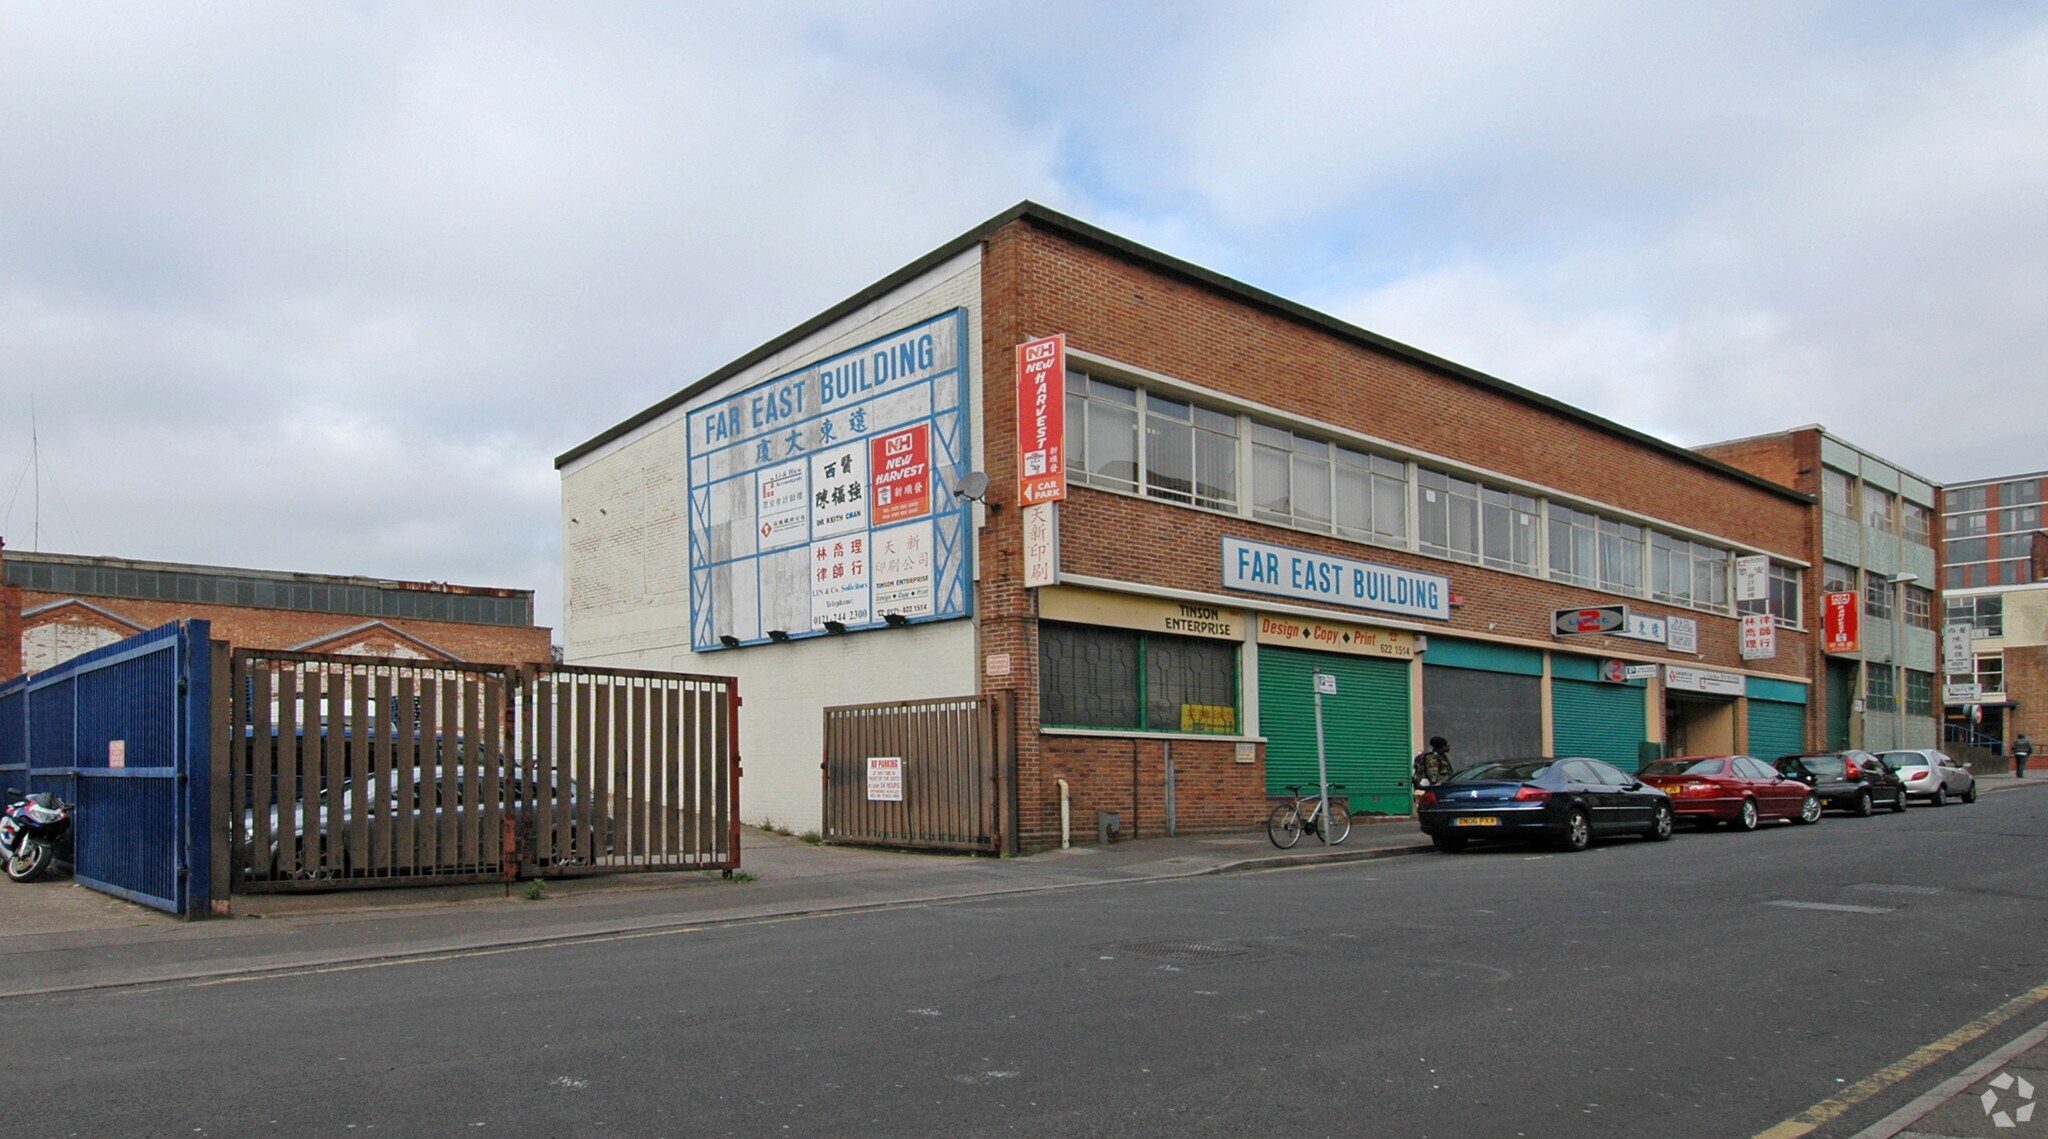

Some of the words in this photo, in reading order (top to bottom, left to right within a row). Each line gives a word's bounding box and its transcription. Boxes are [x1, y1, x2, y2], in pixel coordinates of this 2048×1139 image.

[1026, 358, 1054, 374] NEW
[705, 406, 742, 444] FAR
[752, 380, 806, 428] EAST
[820, 334, 934, 404] BUILDING
[1034, 371, 1048, 450] HARVEST
[886, 454, 913, 470] NEW
[875, 463, 926, 485] HARVEST
[1034, 488, 1060, 499] PARK
[1038, 480, 1056, 490] CAR
[1028, 506, 1049, 580] 天新印刷
[816, 560, 862, 582] 律師行
[1238, 548, 1279, 585] FAR
[1291, 557, 1343, 595] EAST
[1353, 568, 1438, 610] BUILDING
[914, 604, 927, 612] 1514
[1179, 604, 1219, 620] TINSON
[1165, 618, 1231, 636] ENTERPRISE
[1262, 619, 1299, 638] Design
[1314, 625, 1339, 644] Copy
[1353, 631, 1376, 646] Print
[1394, 646, 1410, 656] 1514
